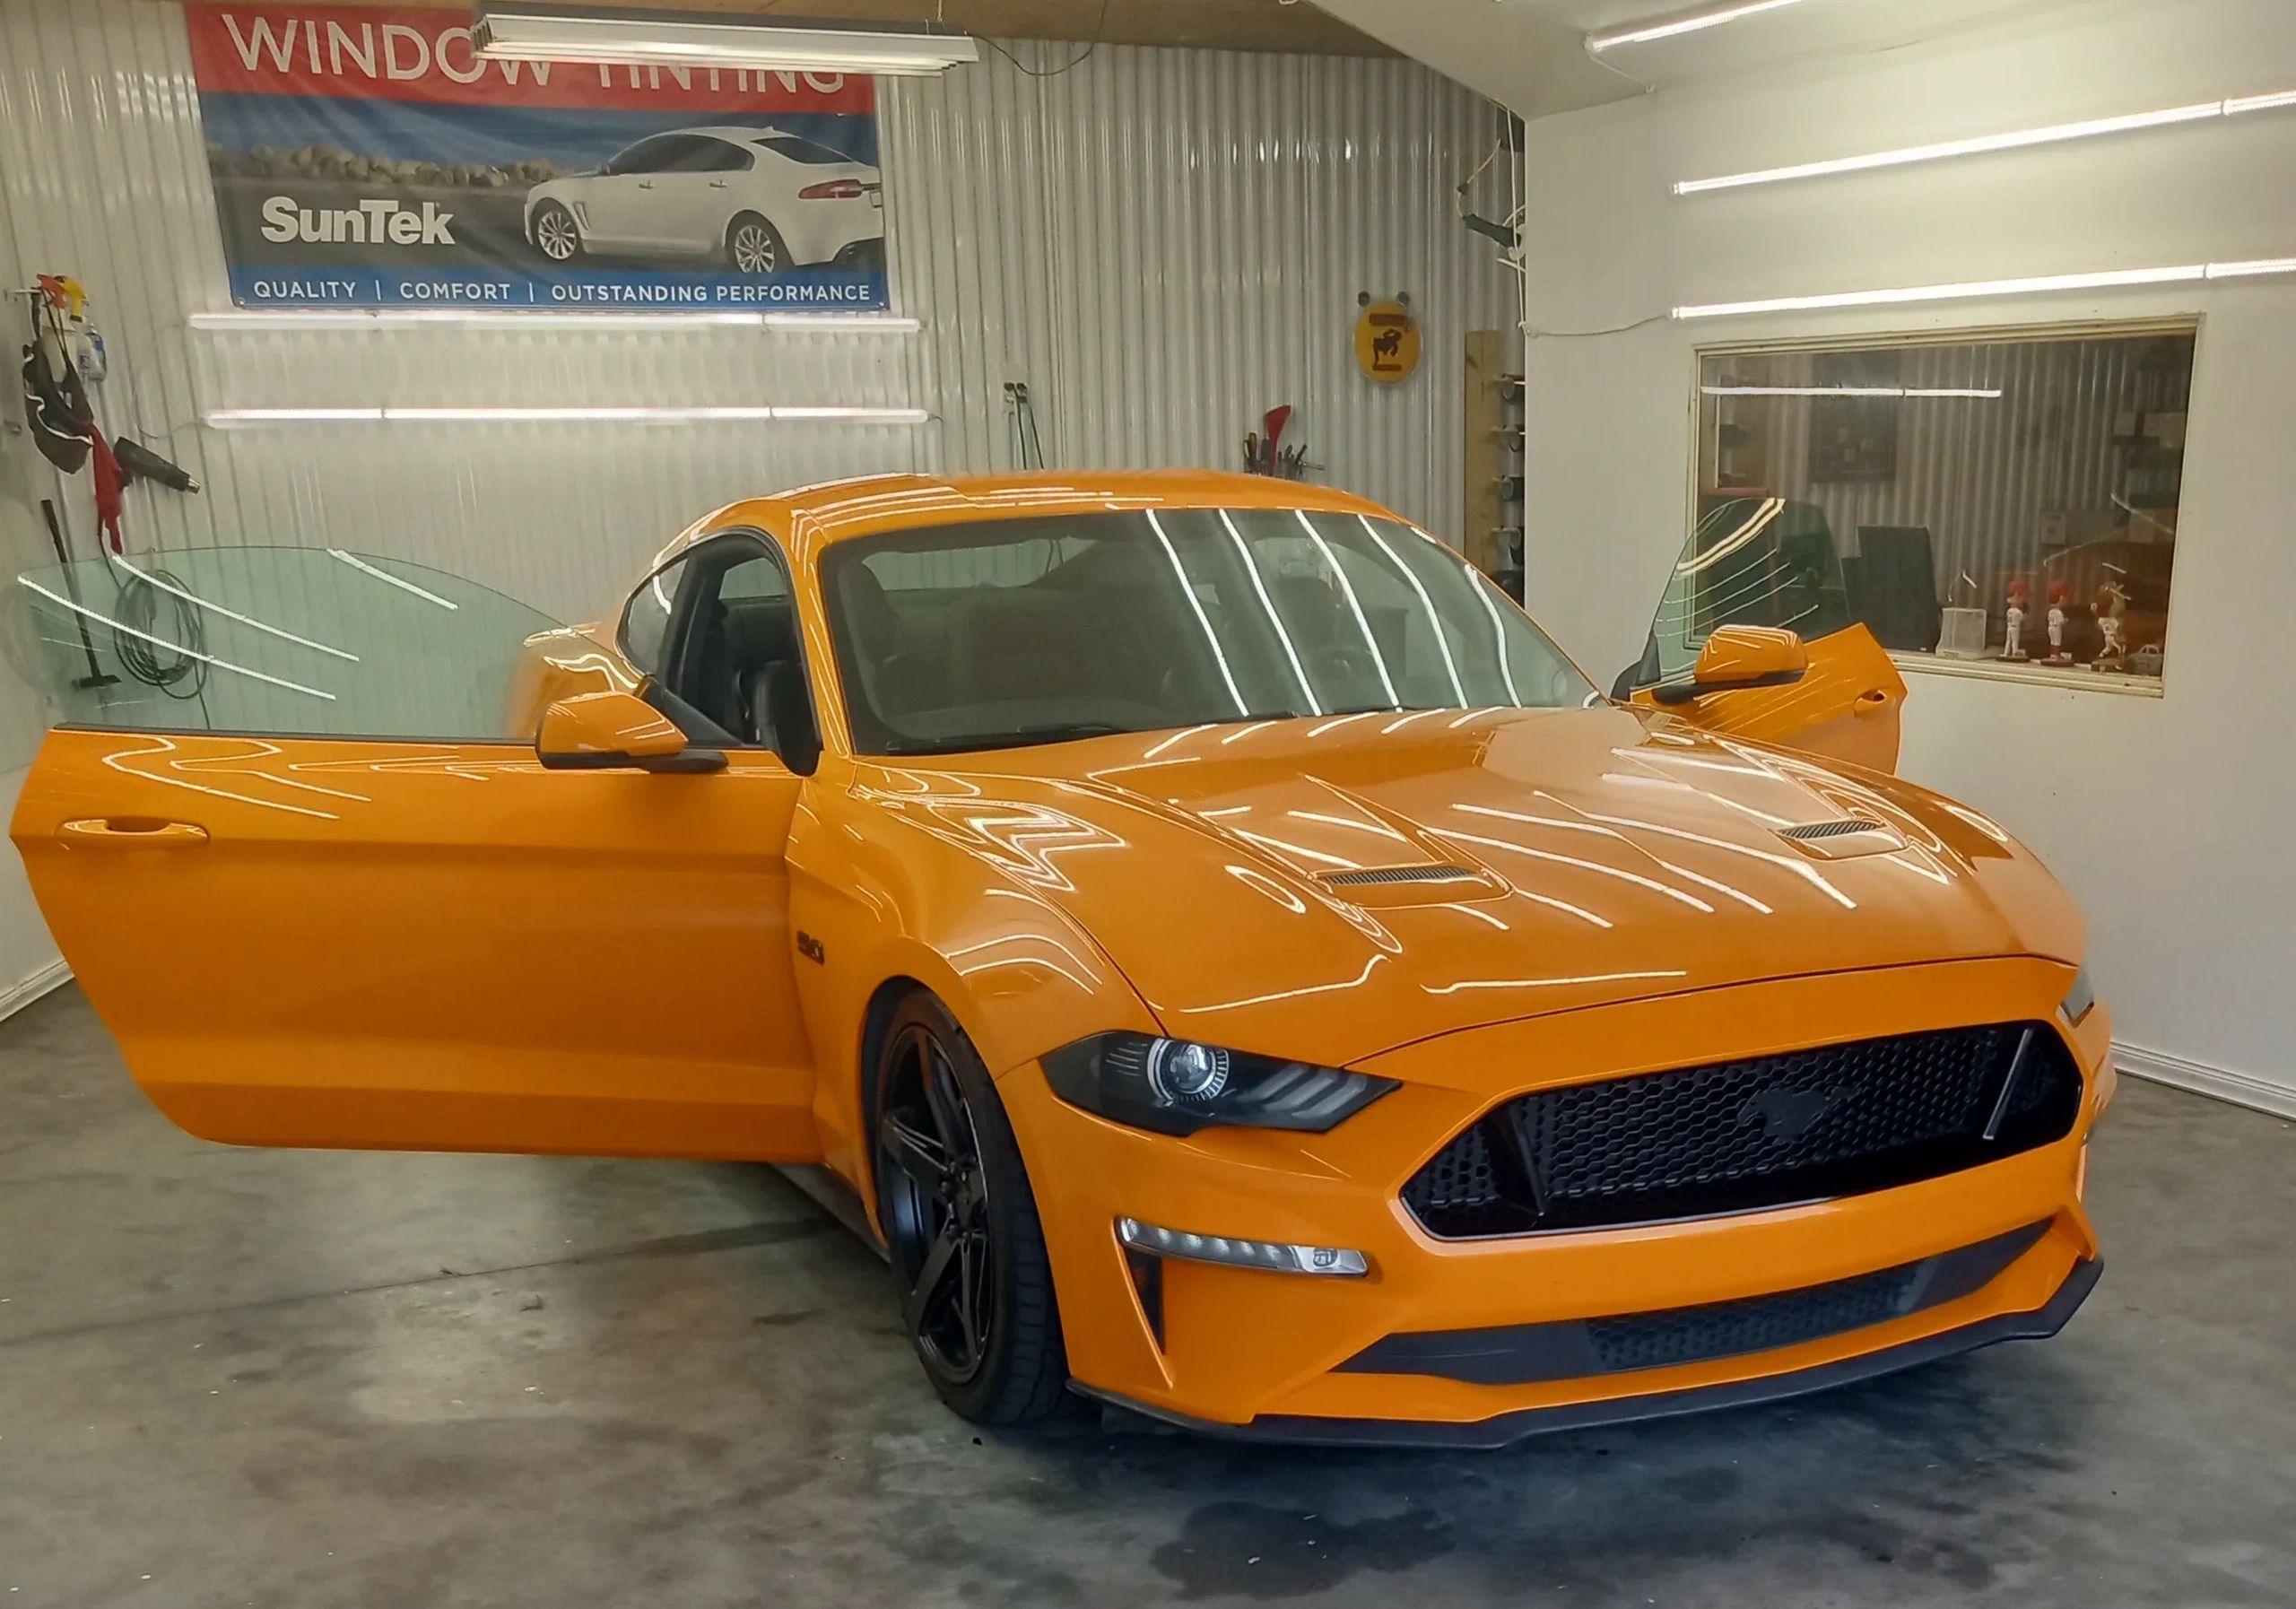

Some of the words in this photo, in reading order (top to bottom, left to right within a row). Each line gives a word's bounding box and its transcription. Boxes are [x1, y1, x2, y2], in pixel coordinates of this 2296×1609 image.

[261, 196, 456, 245] SunTek
[254, 281, 356, 299] QUALITY
[400, 283, 510, 300] COMFORT
[551, 284, 707, 301] OUTSTANDING
[717, 284, 871, 301] PERFORMANCE
